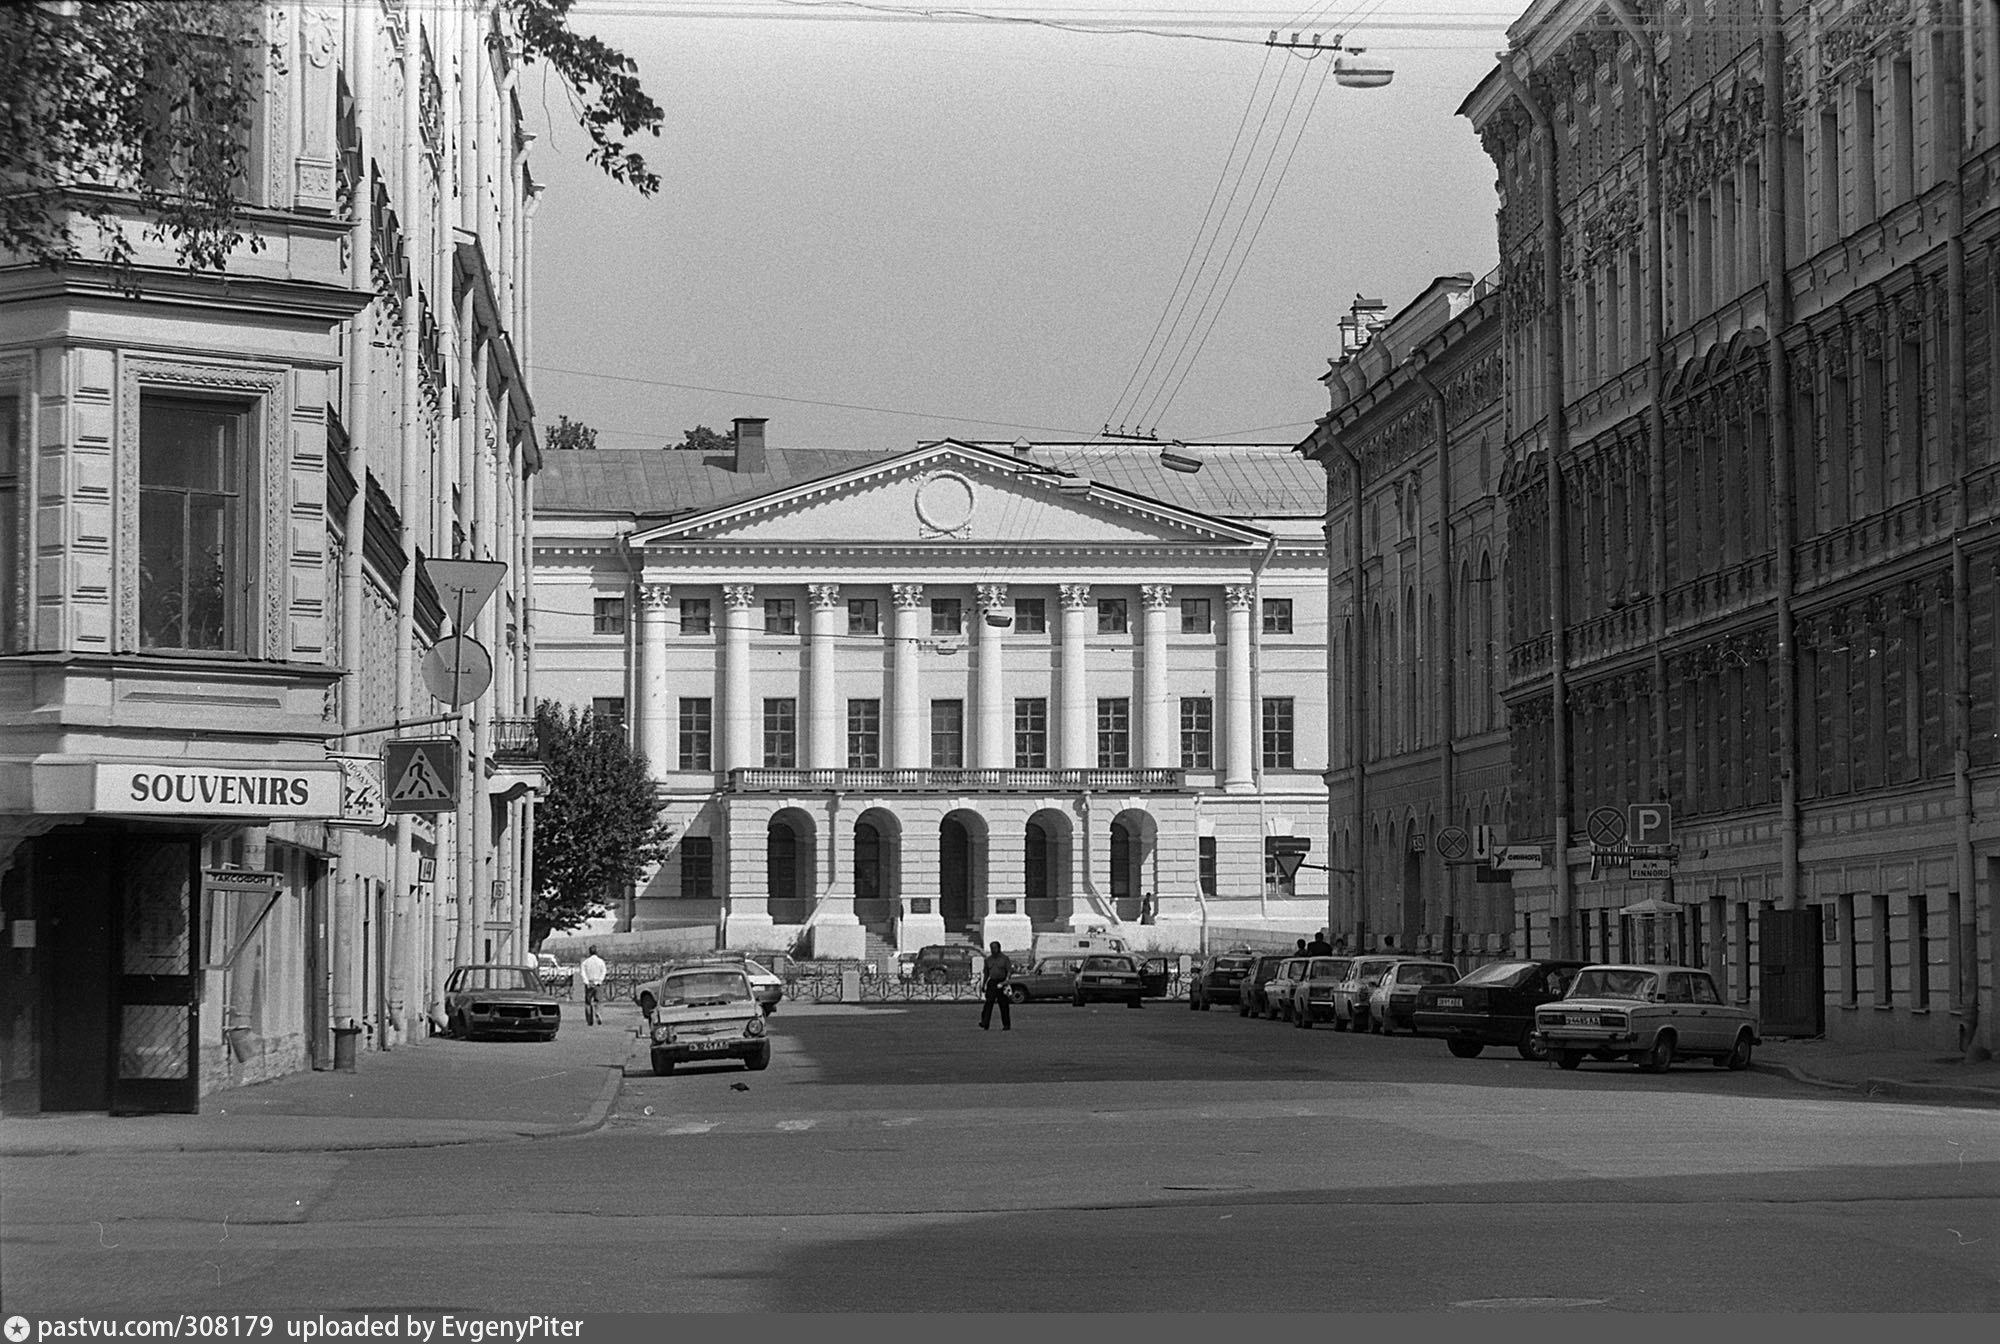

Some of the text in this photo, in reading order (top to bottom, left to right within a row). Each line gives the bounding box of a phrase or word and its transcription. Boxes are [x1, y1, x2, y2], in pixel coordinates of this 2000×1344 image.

[131, 773, 309, 805] SOUVENIRS
[1639, 809, 1662, 841] P
[211, 874, 268, 884] ТАКСОФОН
[1632, 869, 1669, 877] FINNORD
